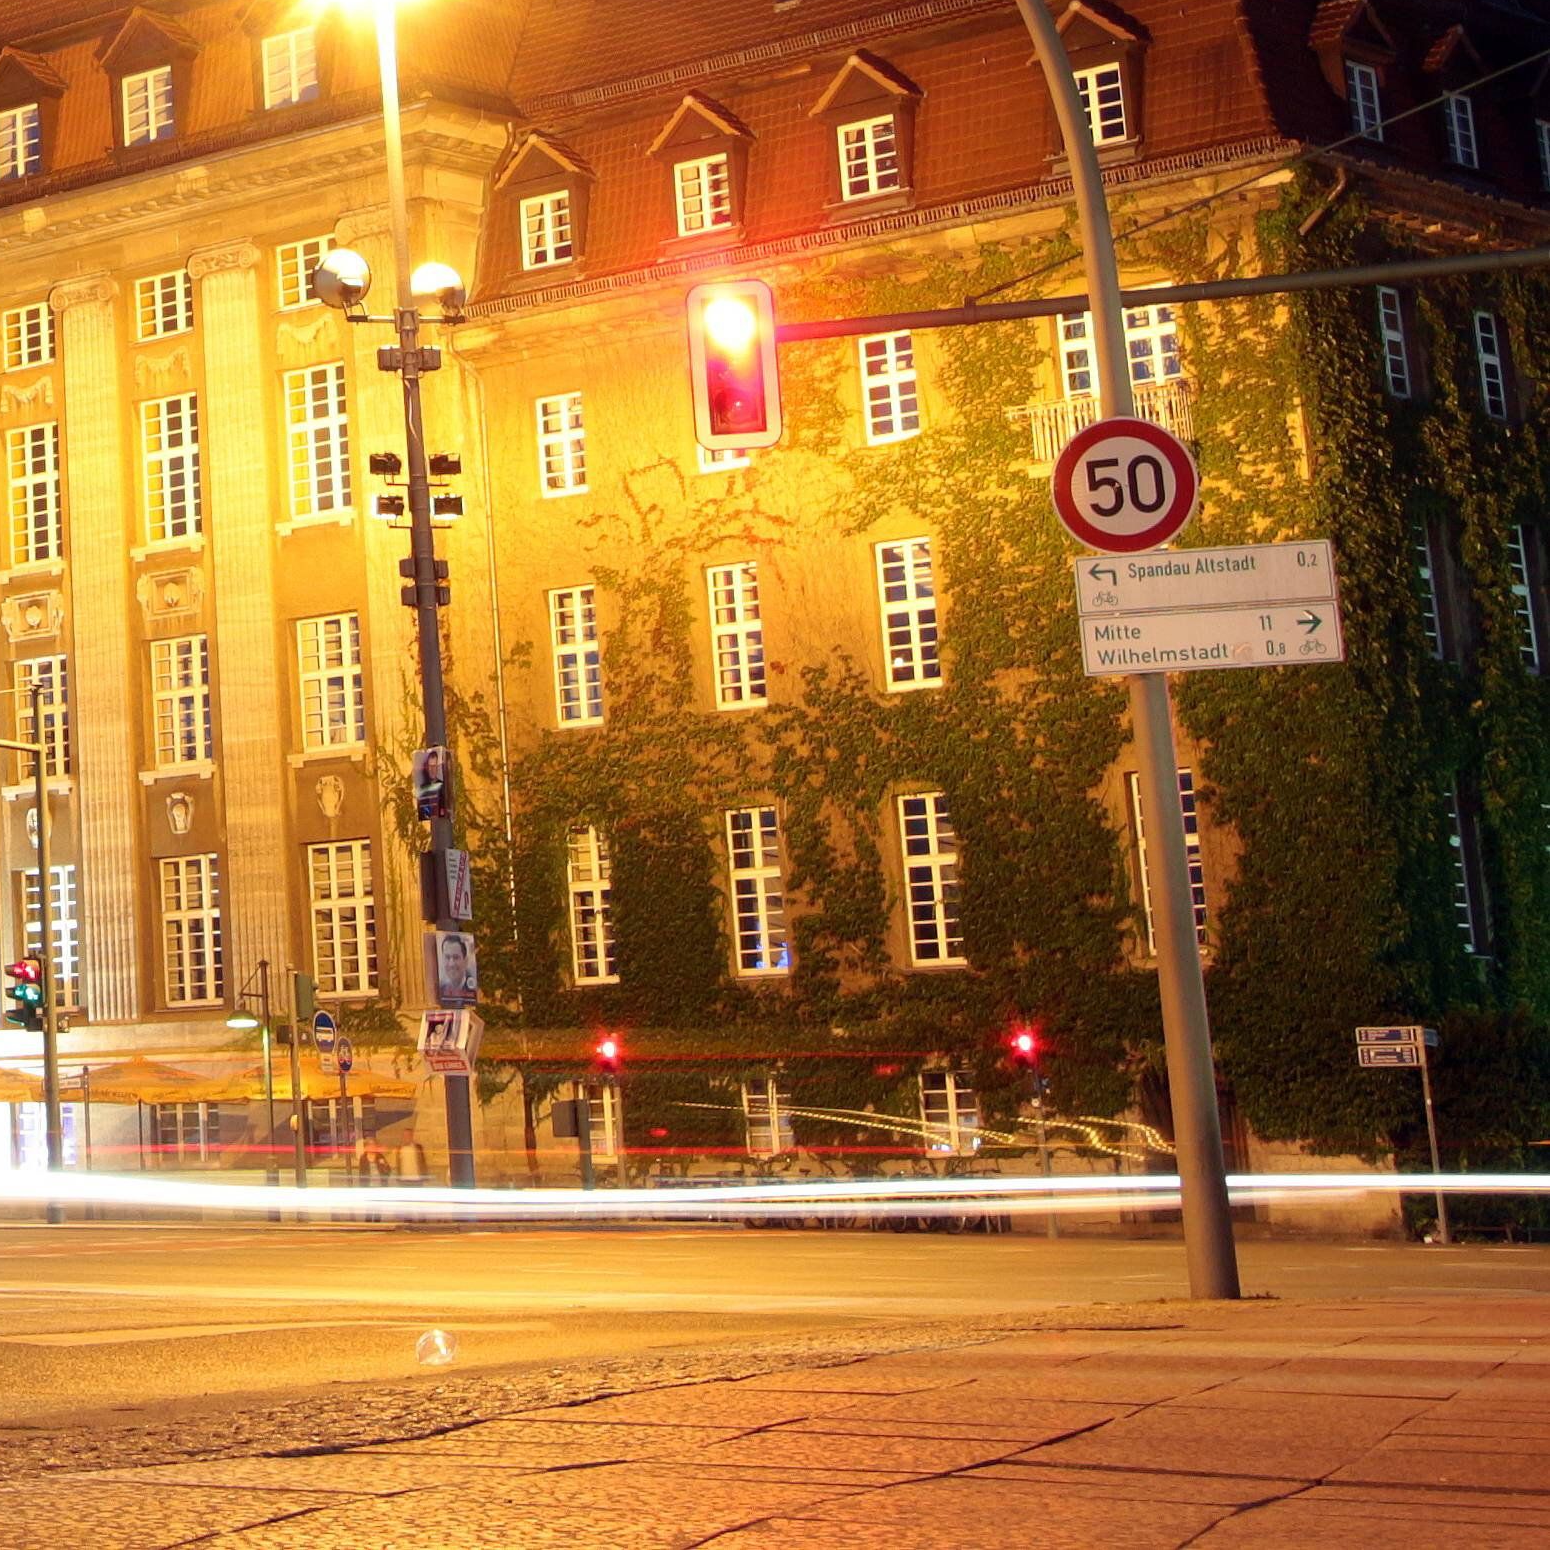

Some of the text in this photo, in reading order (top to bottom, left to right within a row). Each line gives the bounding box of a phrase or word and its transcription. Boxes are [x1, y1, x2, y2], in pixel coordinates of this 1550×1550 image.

[1086, 454, 1166, 518] 50
[1127, 551, 1318, 582] Spandau Altstadt 0,2
[1094, 614, 1273, 642] Mitte 11
[1097, 640, 1286, 666] Wilhelmstadt 0,8
